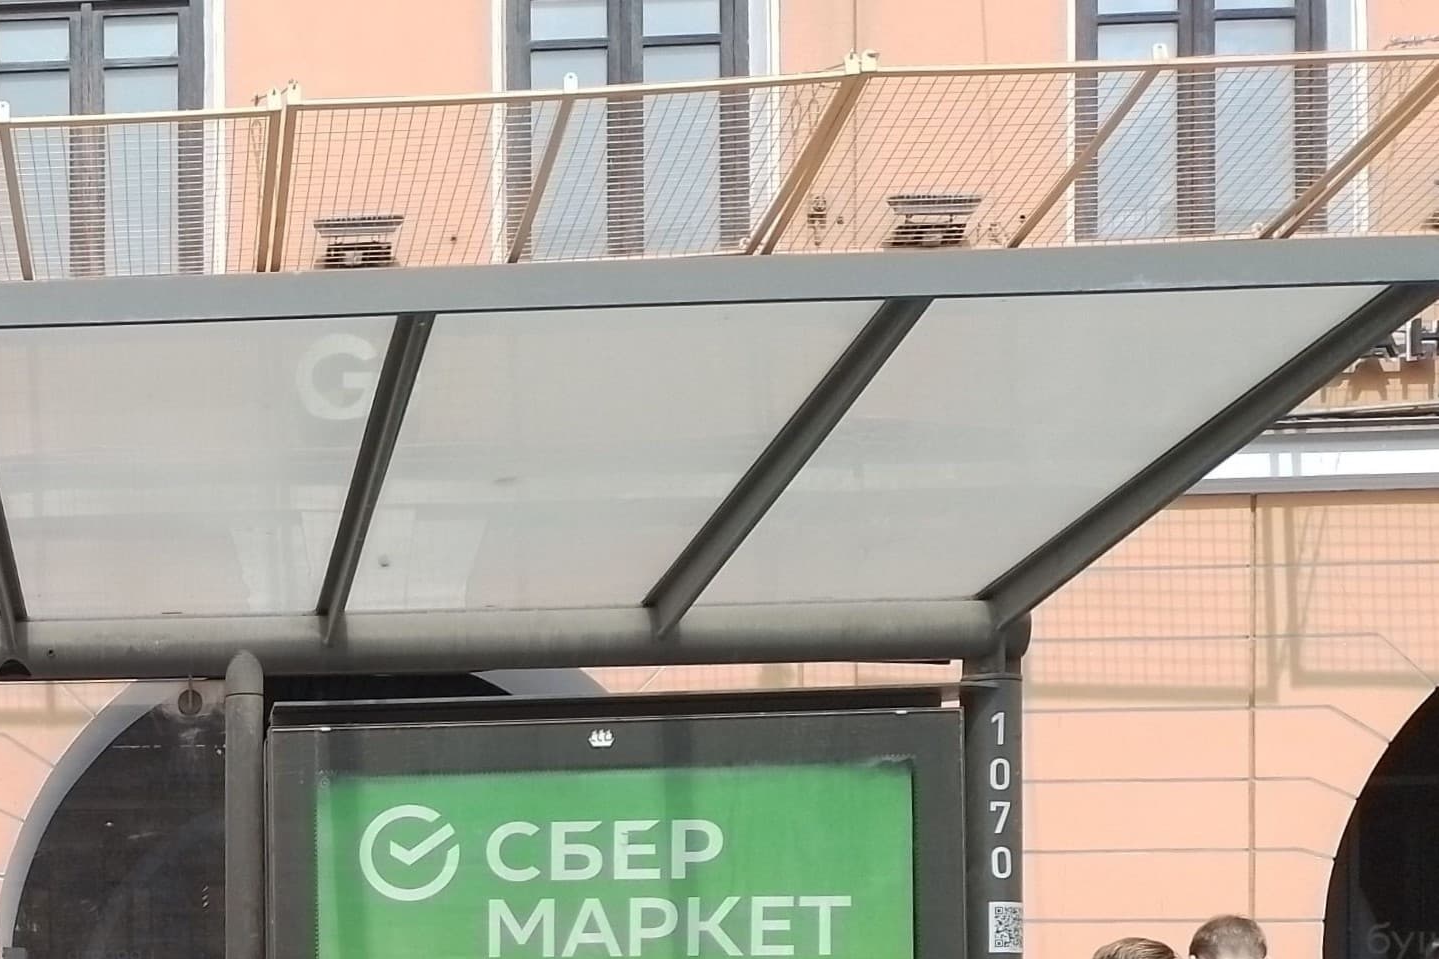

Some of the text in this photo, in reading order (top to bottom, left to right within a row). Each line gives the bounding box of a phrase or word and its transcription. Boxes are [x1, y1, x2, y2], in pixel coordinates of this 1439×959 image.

[989, 711, 1012, 879] 1070
[485, 819, 724, 882] СБЕР
[488, 895, 852, 958] МАРКЕТ
